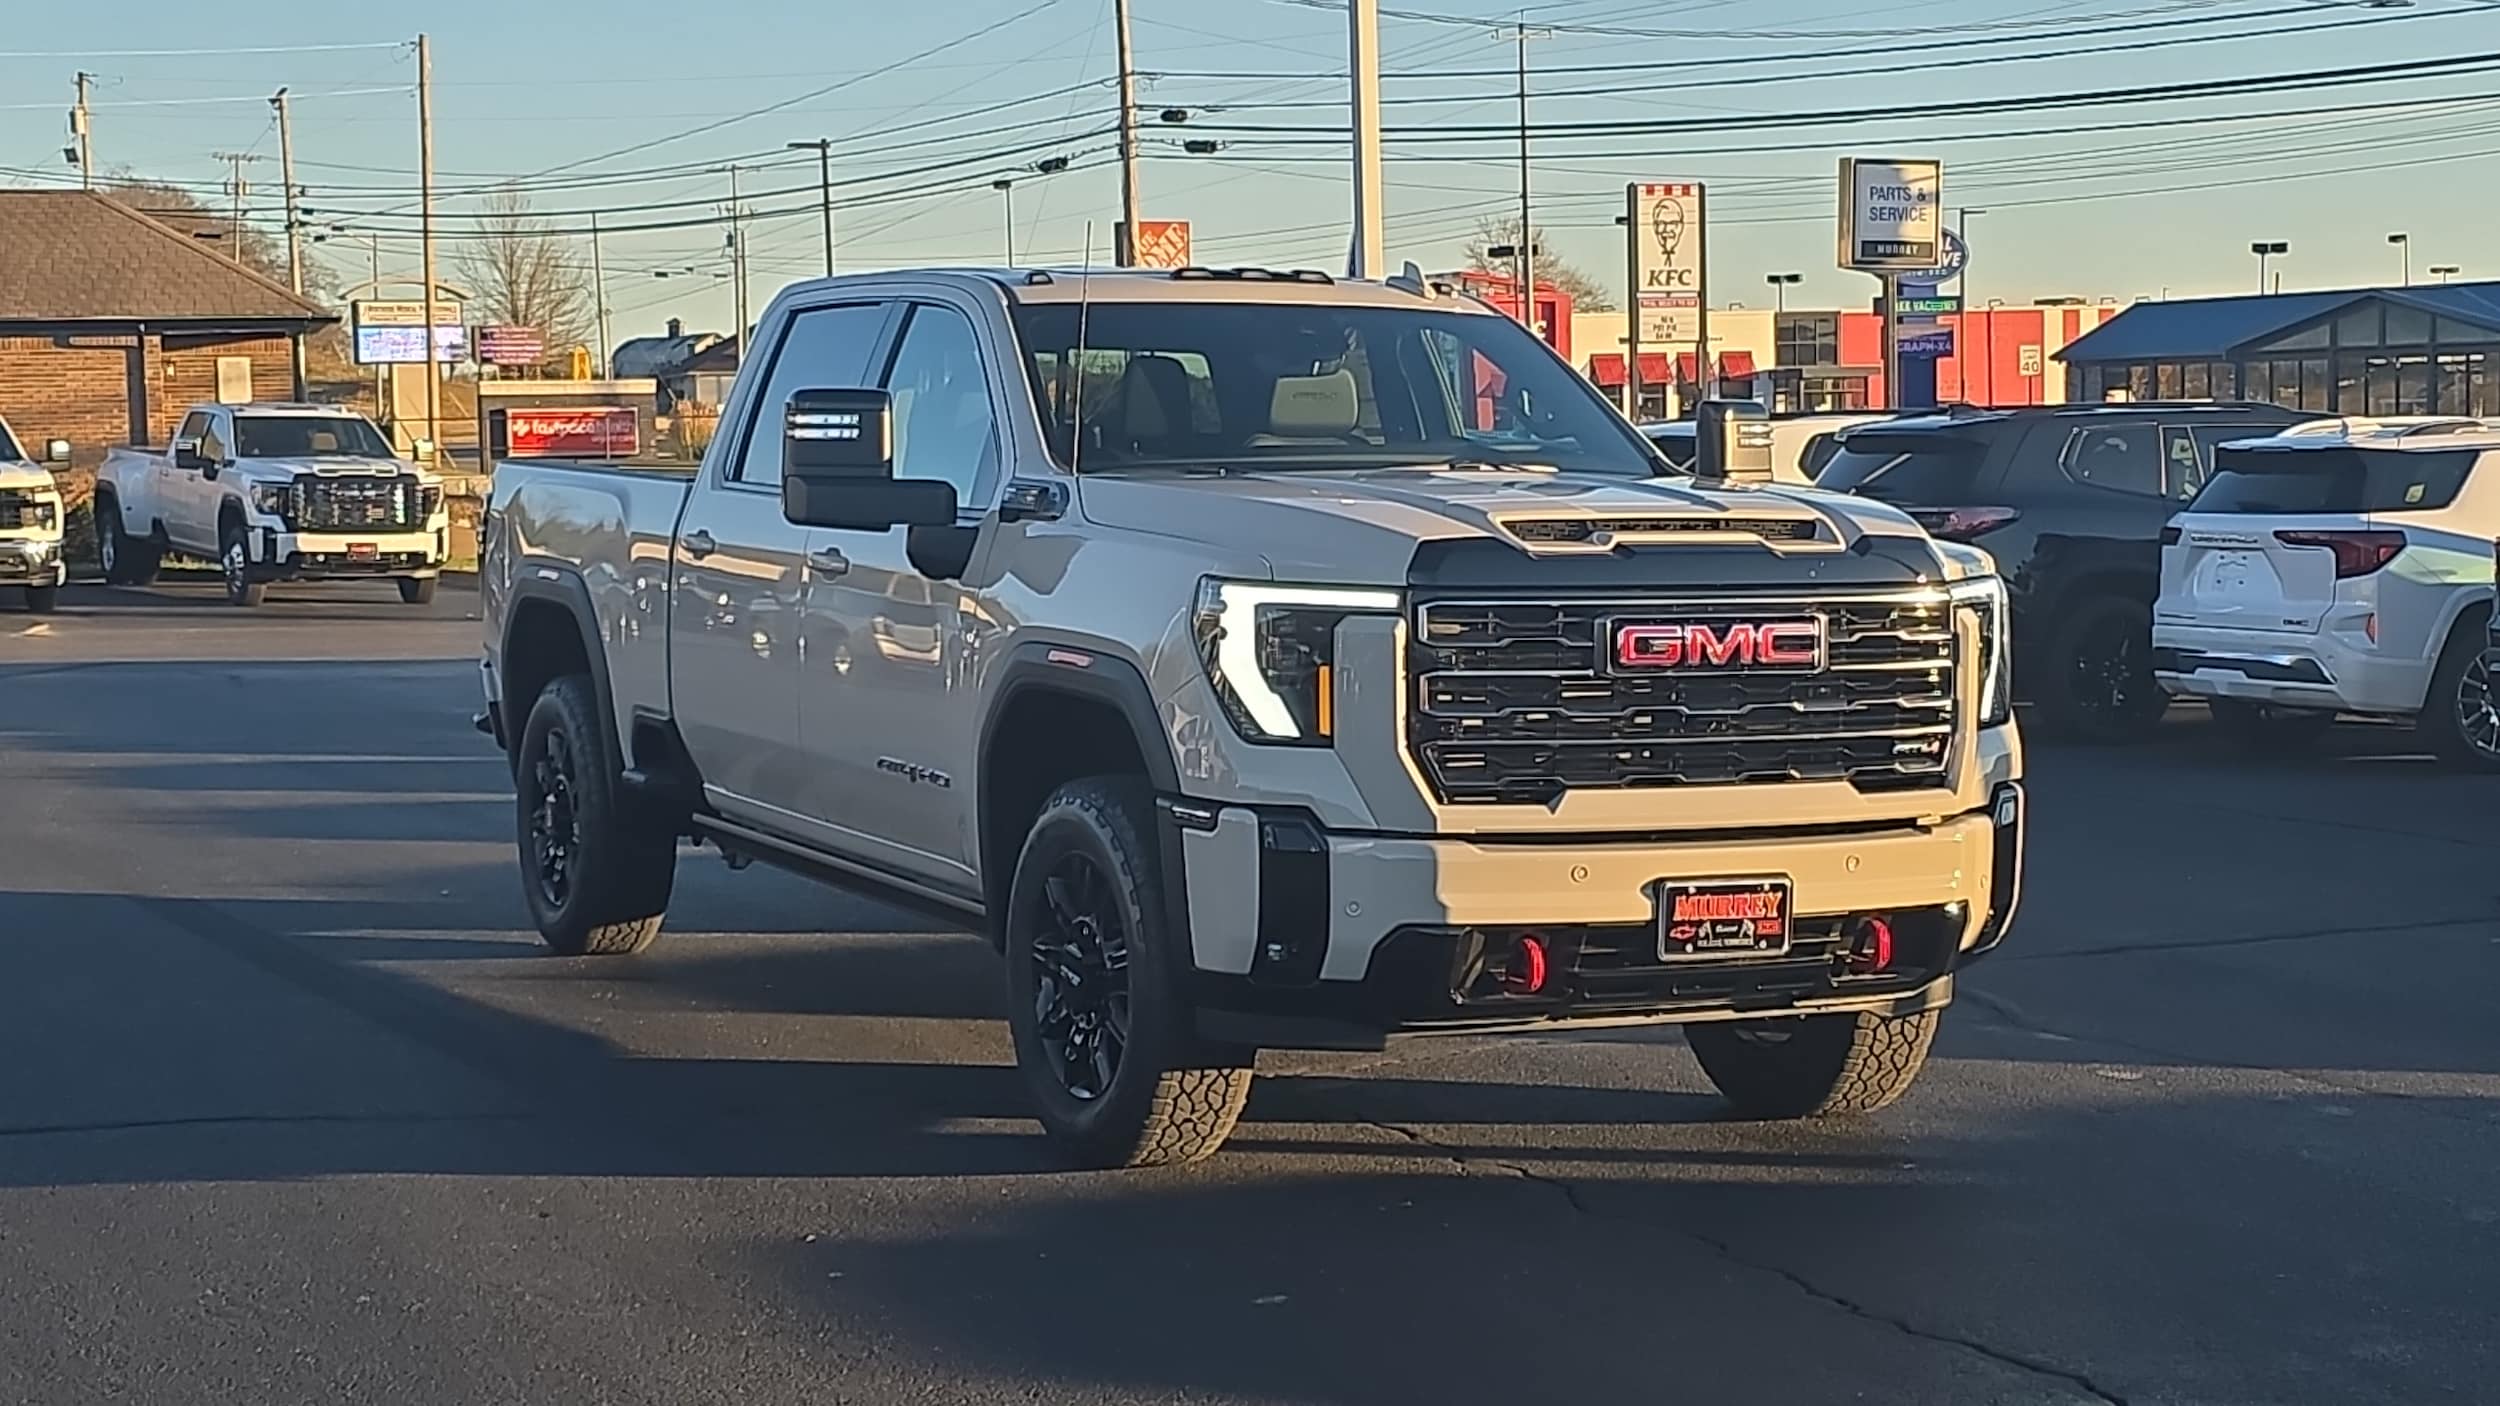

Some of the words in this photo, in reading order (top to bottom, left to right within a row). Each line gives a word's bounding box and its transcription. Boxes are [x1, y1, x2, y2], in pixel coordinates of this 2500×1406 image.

[1869, 186, 1912, 201] PARTS
[1916, 187, 1926, 202] &
[1869, 206, 1928, 222] SERVICE
[1647, 268, 1693, 287] KFC
[2022, 360, 2040, 373] 40
[1617, 623, 1815, 668] GMC
[1672, 891, 1783, 922] MURREY
